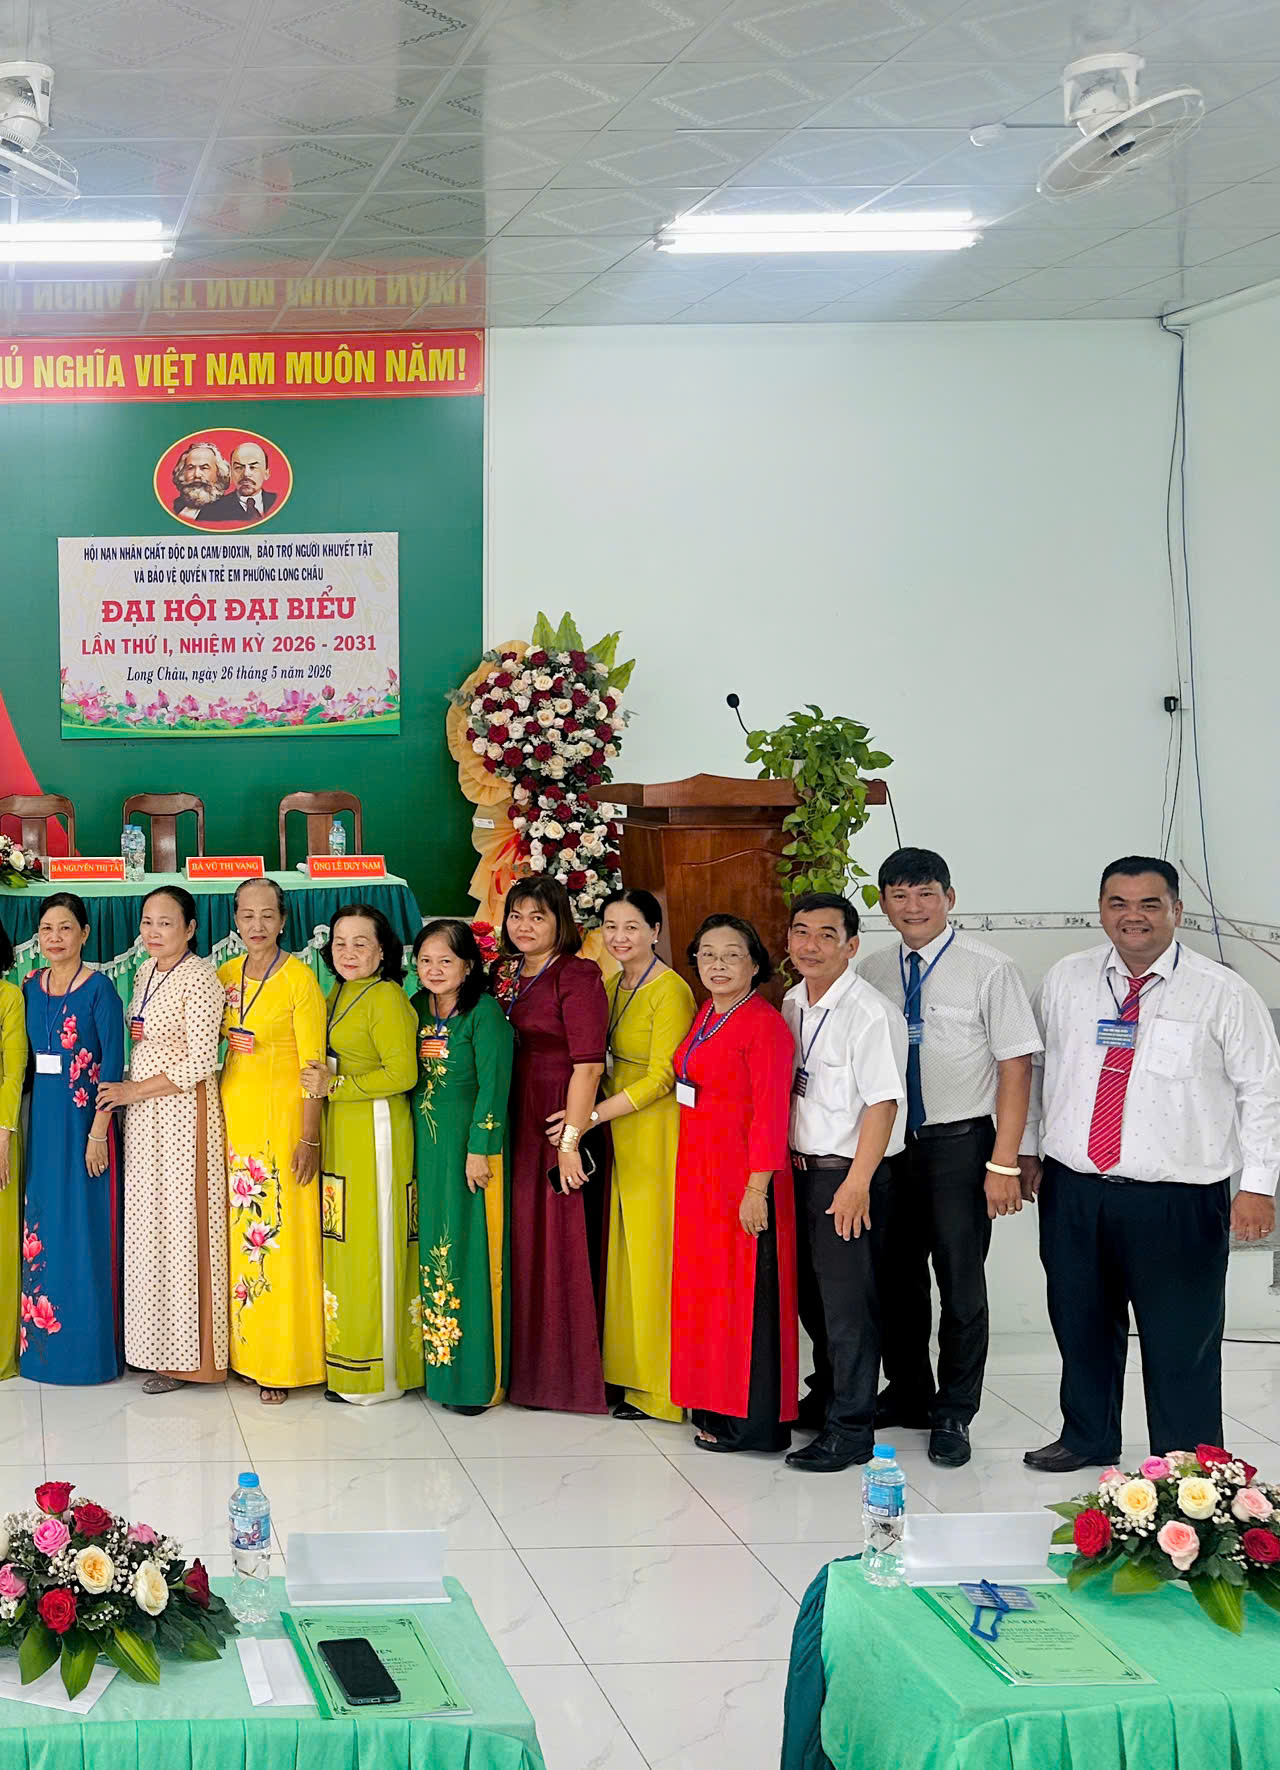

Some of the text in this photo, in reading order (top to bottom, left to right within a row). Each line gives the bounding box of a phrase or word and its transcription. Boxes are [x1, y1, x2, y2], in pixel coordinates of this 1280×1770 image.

[33, 348, 126, 388] NGHĨA
[134, 347, 197, 394] VIỆT
[206, 352, 275, 386] NAM
[285, 344, 376, 384] MUÔN
[385, 342, 466, 382] NĂM!
[84, 544, 98, 562] HỘI
[100, 547, 118, 562] NẠN
[120, 544, 142, 560] NHÂN
[144, 541, 166, 560] CHẤT
[168, 543, 185, 561] ĐỘC
[187, 546, 199, 559] DA
[257, 540, 274, 558] BẢO
[276, 542, 294, 560] TRỢ
[295, 541, 320, 558] NGƯỜI
[322, 538, 355, 557] KHUYẾT
[357, 540, 373, 559] TẬT
[134, 564, 324, 585] VÀ BẢO VỆ QUYỀN TRẺ EM PHƯỜNG LONG CHÂU
[101, 585, 357, 628] ĐẠI HỘI ĐẠI BIỂU
[81, 632, 116, 655] LẦN
[121, 634, 158, 655] THỨ
[162, 637, 173, 657] I,
[179, 633, 236, 656] NHIỆM
[242, 632, 265, 653] KỲ
[272, 636, 316, 652] 2026
[333, 635, 377, 651] 2031
[126, 664, 333, 685] Long Châu, ngày 26 tháng 5 năm 2026
